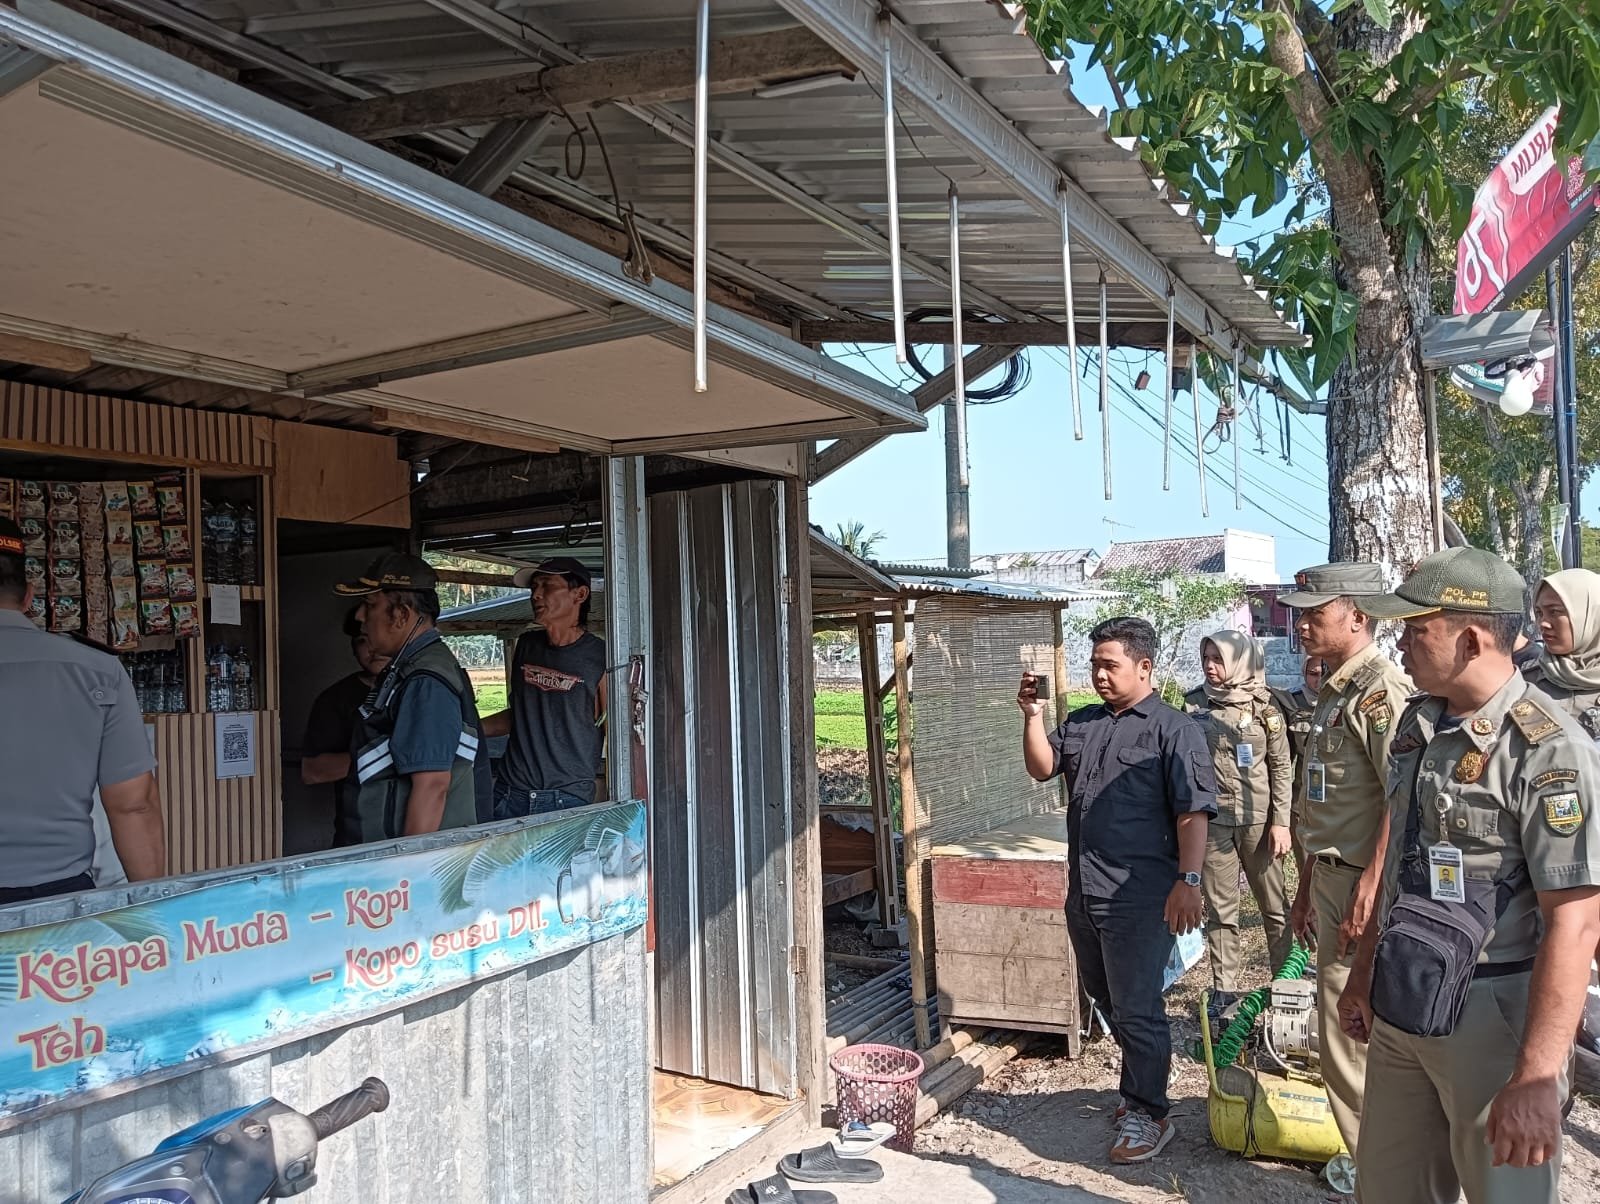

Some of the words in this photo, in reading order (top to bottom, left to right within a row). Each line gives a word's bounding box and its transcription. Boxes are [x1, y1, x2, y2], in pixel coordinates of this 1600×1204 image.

[21, 488, 41, 497] TOP
[1445, 587, 1466, 597] POL
[1472, 591, 1487, 599] PP
[19, 939, 168, 1002] Kelapa
[184, 911, 288, 961] Muda
[345, 880, 410, 929] Kopi
[345, 940, 420, 987] Kopo
[432, 920, 499, 958] susu
[18, 1018, 105, 1071] Teh
